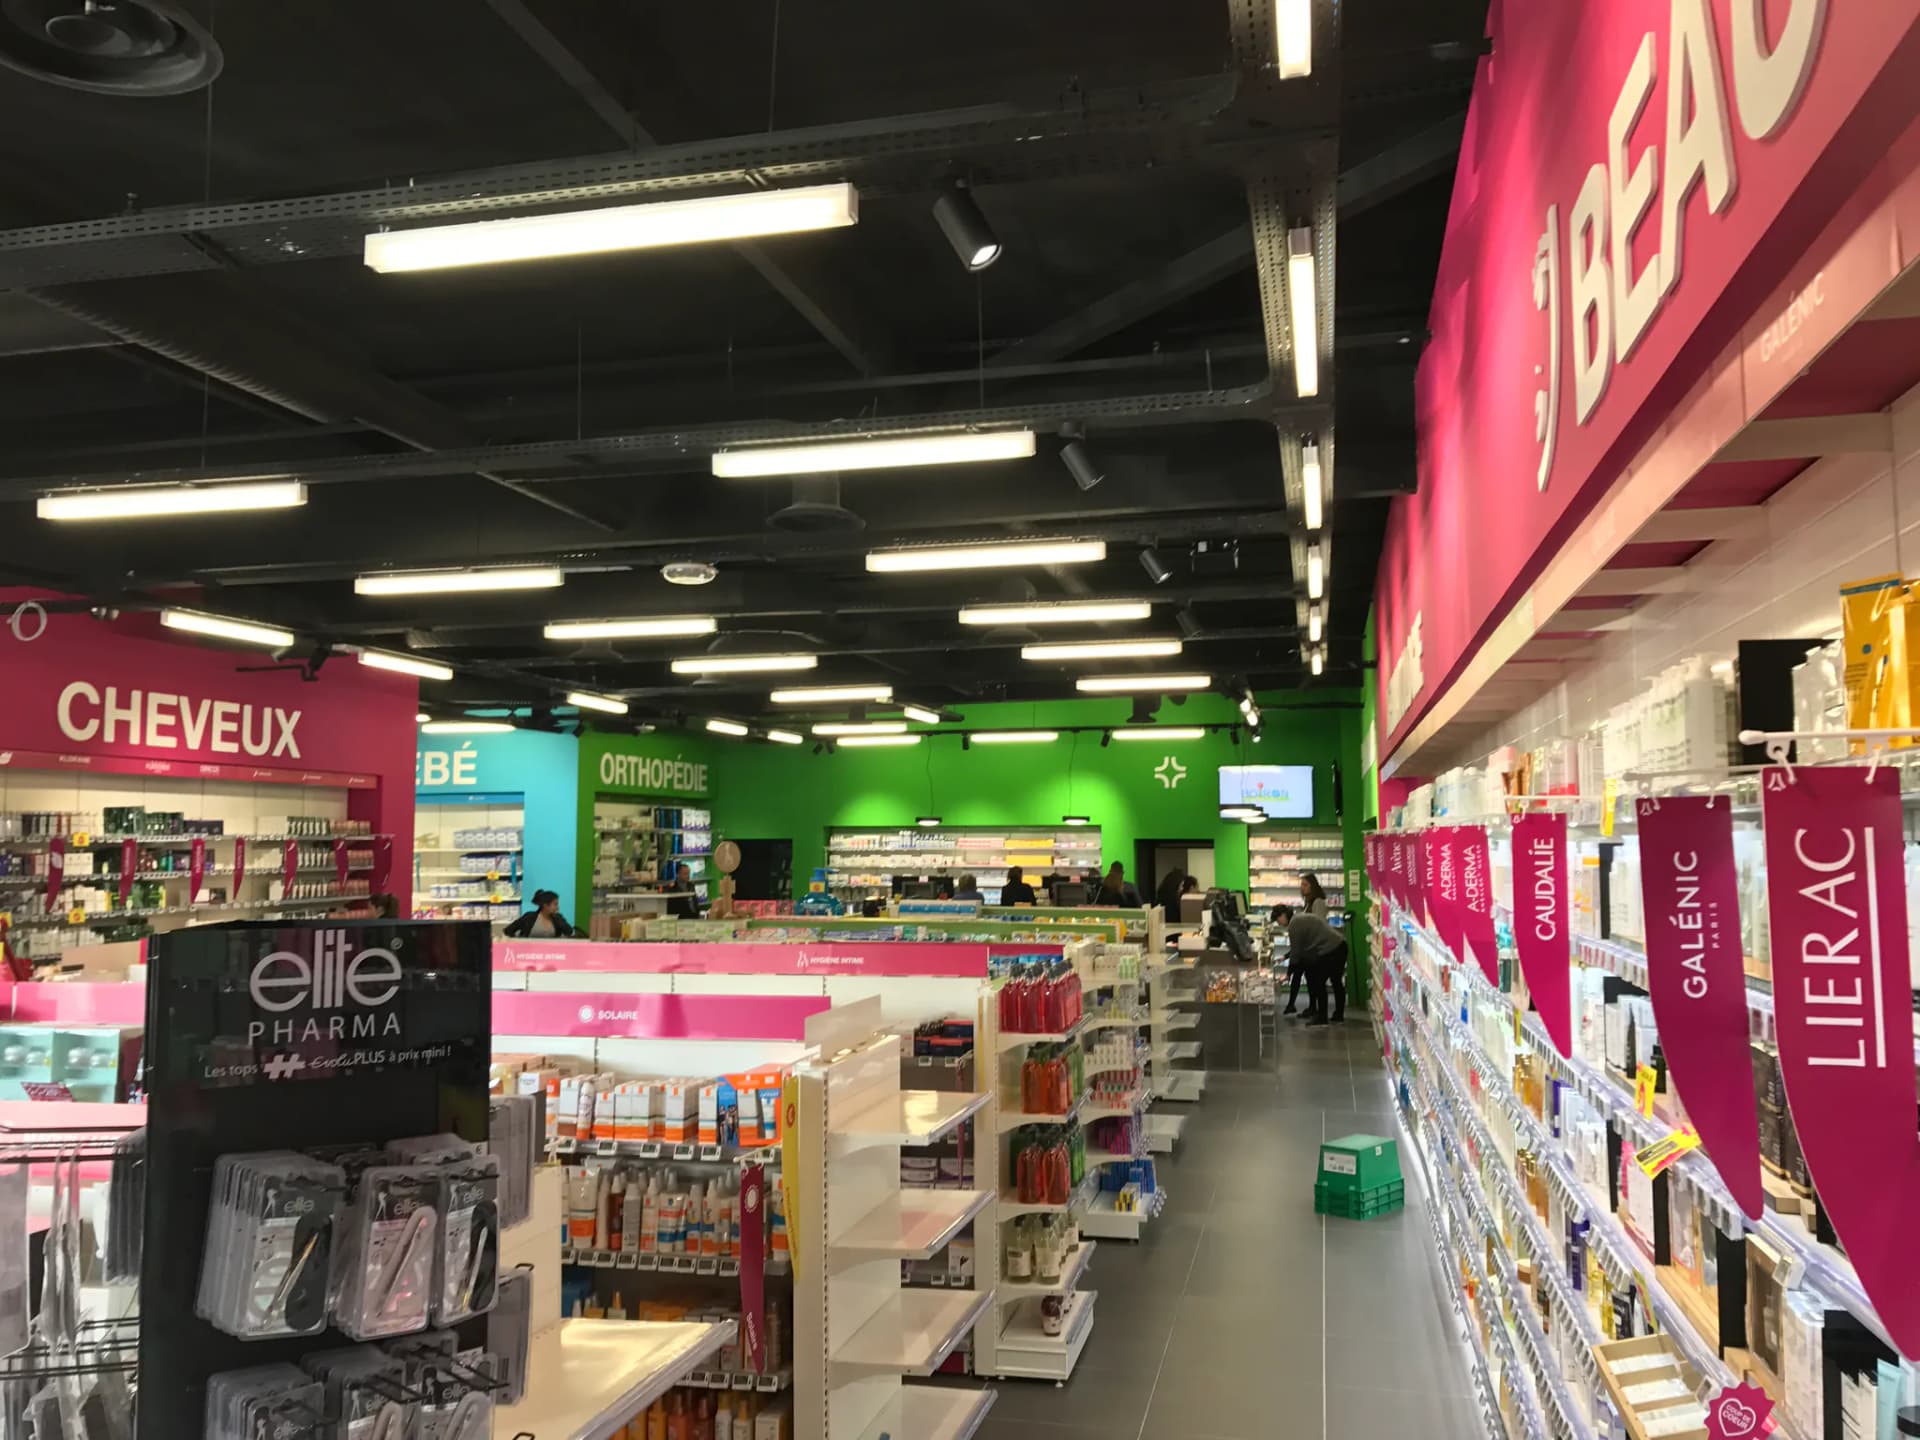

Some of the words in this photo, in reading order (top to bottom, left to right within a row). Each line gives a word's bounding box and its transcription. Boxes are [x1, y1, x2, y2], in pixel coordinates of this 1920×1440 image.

[57, 681, 302, 759] CHEVEUX
[600, 752, 708, 792] ORTHOPÉDIE
[1440, 842, 1452, 901] A-DERMA
[1463, 844, 1480, 913] A-DERMA
[1669, 850, 1708, 999] GALÉNIC
[1794, 827, 1867, 1068] LIERAC
[250, 929, 402, 1013] elite
[248, 1012, 402, 1046] PHARMA
[597, 1010, 639, 1021] SOLAIRE
[204, 1065, 227, 1078] Les
[229, 1063, 258, 1078] tops
[389, 1049, 396, 1062] à
[398, 1048, 419, 1064] prix
